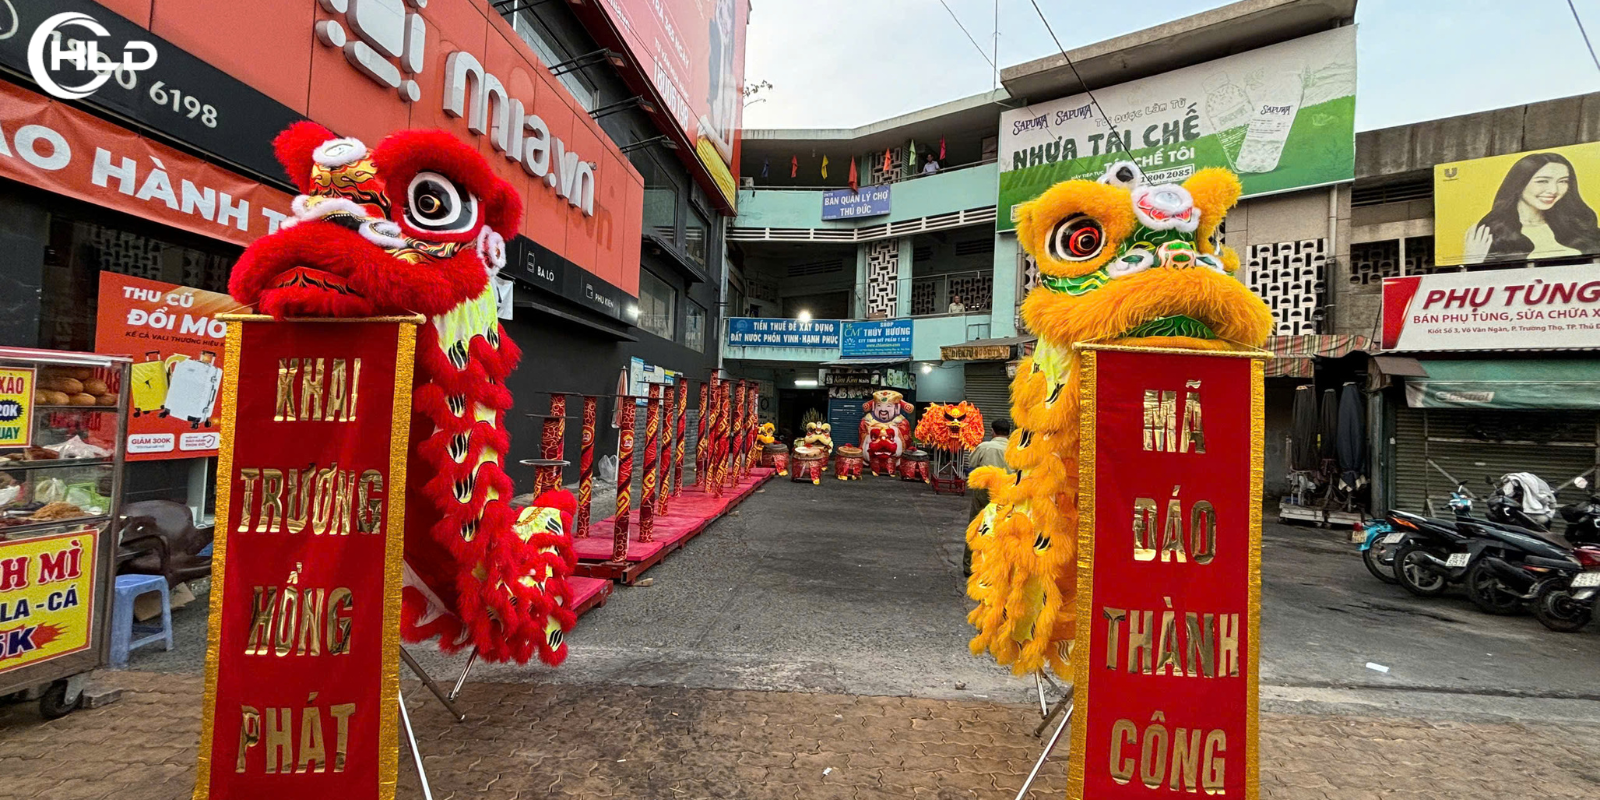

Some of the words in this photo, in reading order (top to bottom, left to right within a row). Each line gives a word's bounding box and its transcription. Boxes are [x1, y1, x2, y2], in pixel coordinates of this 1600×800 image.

[149, 80, 218, 129] 6198
[1055, 103, 1093, 126] SAPUWA
[443, 51, 594, 217] mia.vn
[1012, 135, 1078, 171] NHỰA
[1087, 124, 1132, 157] TÁI
[1142, 101, 1201, 148] CHẾ
[1167, 145, 1196, 163] TÔI
[0, 122, 72, 171] O
[91, 146, 250, 232] HÀNH
[824, 196, 839, 206] BAN
[840, 192, 860, 205] QUẢN
[861, 191, 871, 202] LÝ
[872, 189, 889, 201] CHỢ
[1140, 172, 1165, 183] 1800
[1166, 168, 1190, 180] 2085
[840, 203, 855, 217] THỦ
[856, 203, 872, 214] ĐỨC
[537, 265, 545, 278] BA
[546, 269, 555, 281] LÔ
[1422, 287, 1495, 312] PHỤ
[1503, 279, 1600, 306] TÙNG
[123, 286, 161, 303] THU
[166, 292, 194, 308] CŨ
[127, 306, 176, 330] ĐỔI
[1413, 313, 1439, 323] BÁN
[1442, 313, 1469, 324] PHỤ
[1472, 311, 1513, 322] TÙNG,
[1516, 308, 1544, 320] SỬA
[1547, 307, 1588, 319] CHỮA
[152, 334, 169, 342] VALI
[273, 358, 361, 422] KHAI
[1143, 379, 1206, 454] MÃ
[237, 462, 383, 535] TRƯƠNG
[1133, 485, 1217, 565] ĐÁO
[38, 539, 83, 585] MÌ
[1103, 597, 1240, 678] THÀNH
[235, 692, 356, 774] PHÁT
[1109, 711, 1227, 796] CÔNG
